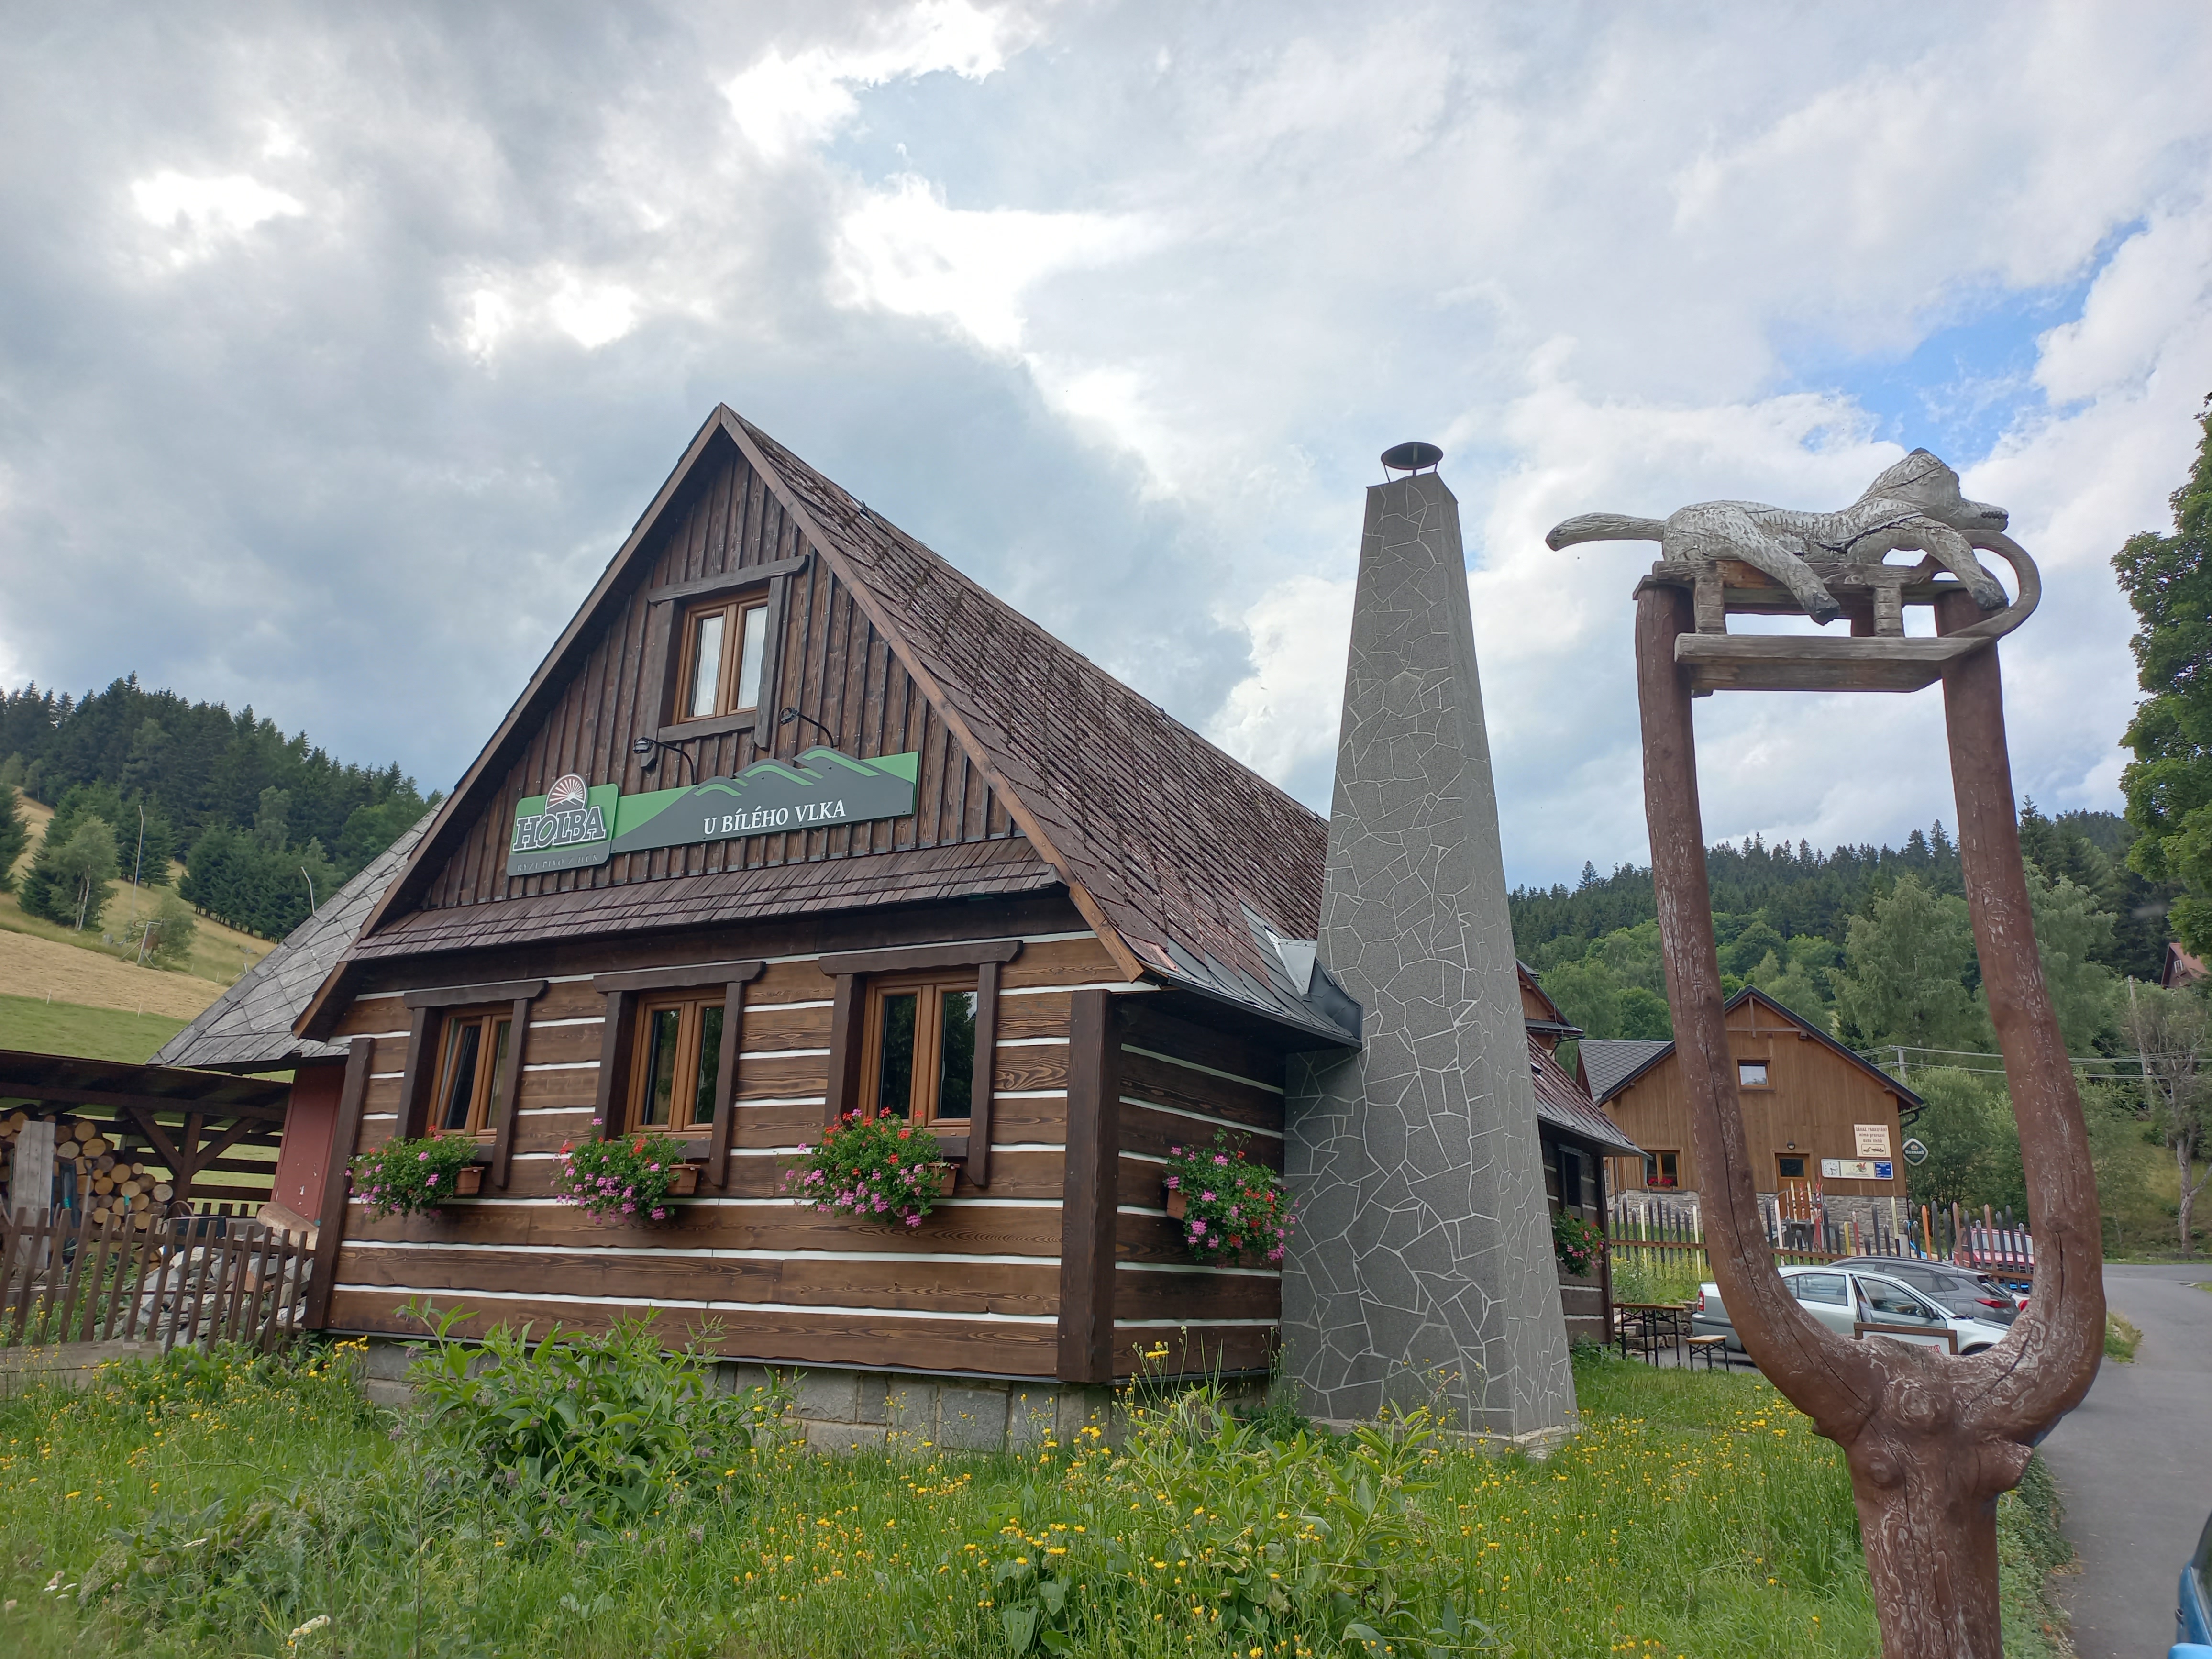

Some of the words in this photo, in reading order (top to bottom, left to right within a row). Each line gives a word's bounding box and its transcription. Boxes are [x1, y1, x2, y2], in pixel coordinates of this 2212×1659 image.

[512, 806, 607, 852] HOLBA
[704, 817, 717, 835] U
[720, 805, 789, 833] BÍLÉHO
[795, 799, 846, 822] VLKA
[542, 858, 564, 868] PIVO
[568, 857, 574, 865] Z
[577, 854, 597, 863] HOR
